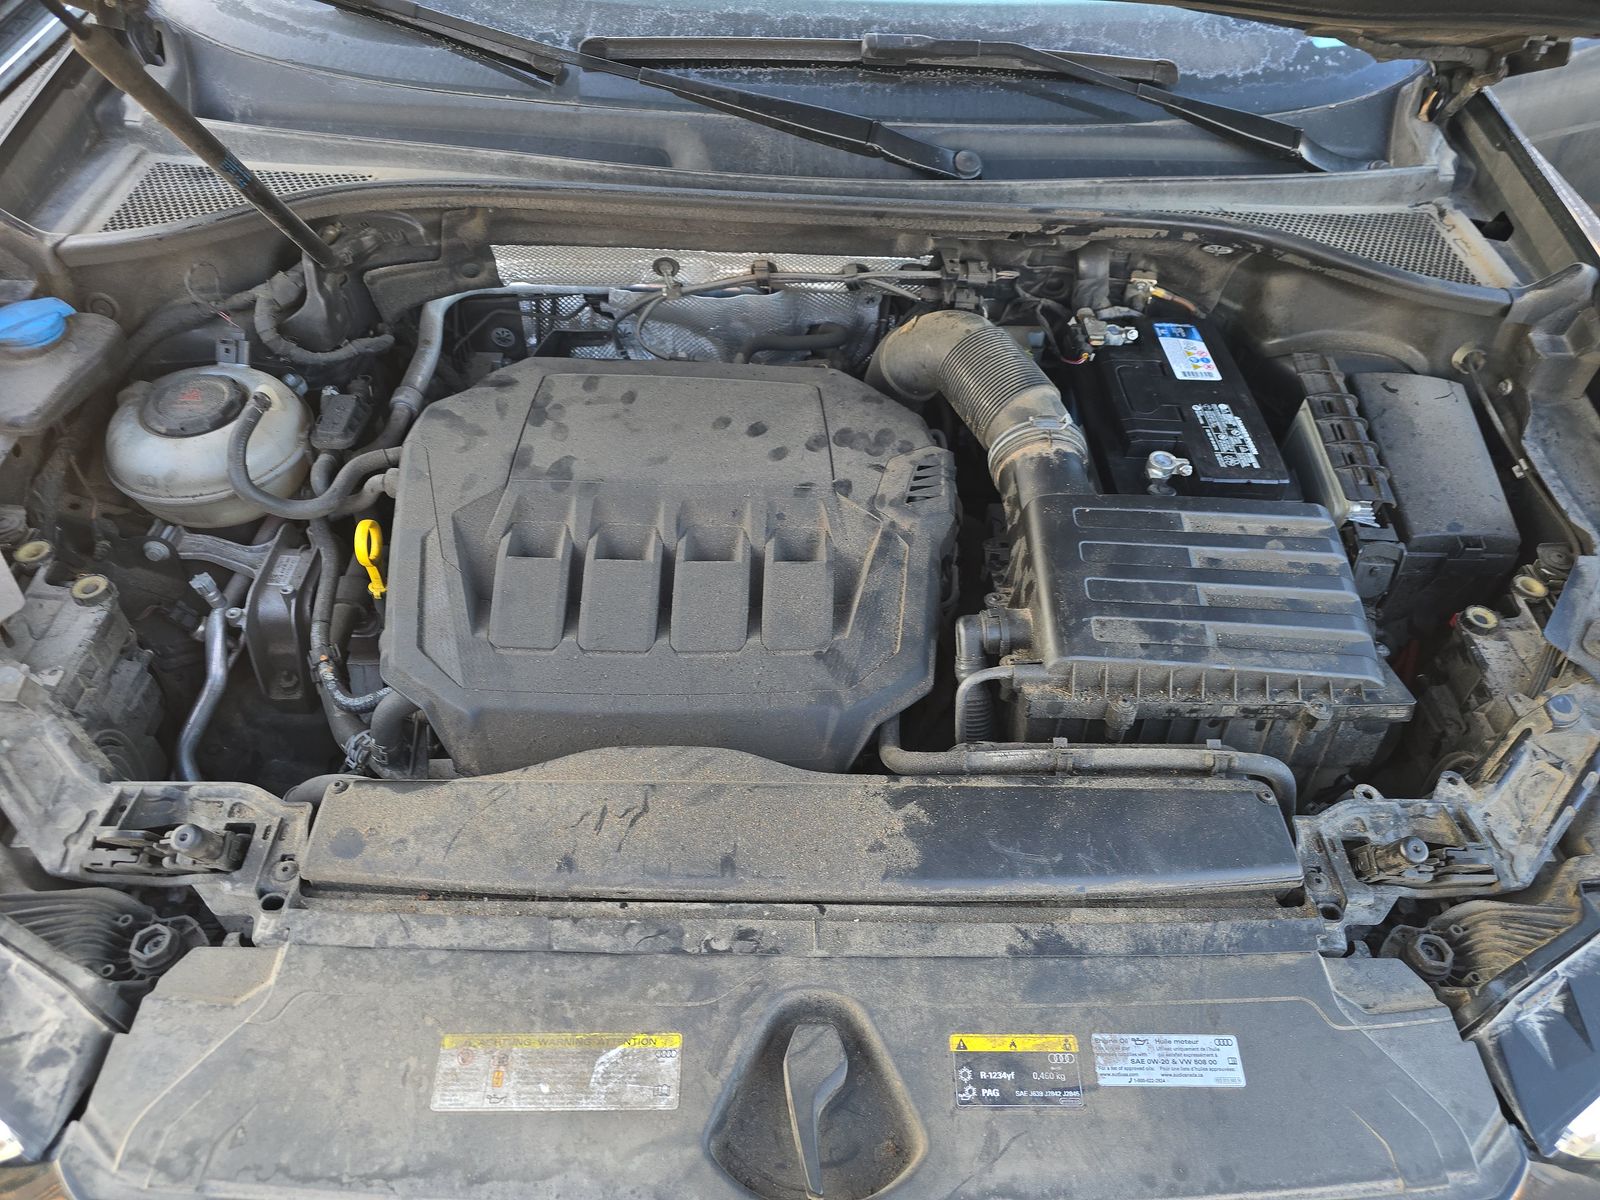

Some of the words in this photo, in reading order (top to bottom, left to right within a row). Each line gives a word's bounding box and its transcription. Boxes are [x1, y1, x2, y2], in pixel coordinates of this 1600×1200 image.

[980, 1071, 1015, 1081] R-1234yf
[1056, 1071, 1066, 1081] kg
[981, 1088, 1000, 1097] PAG
